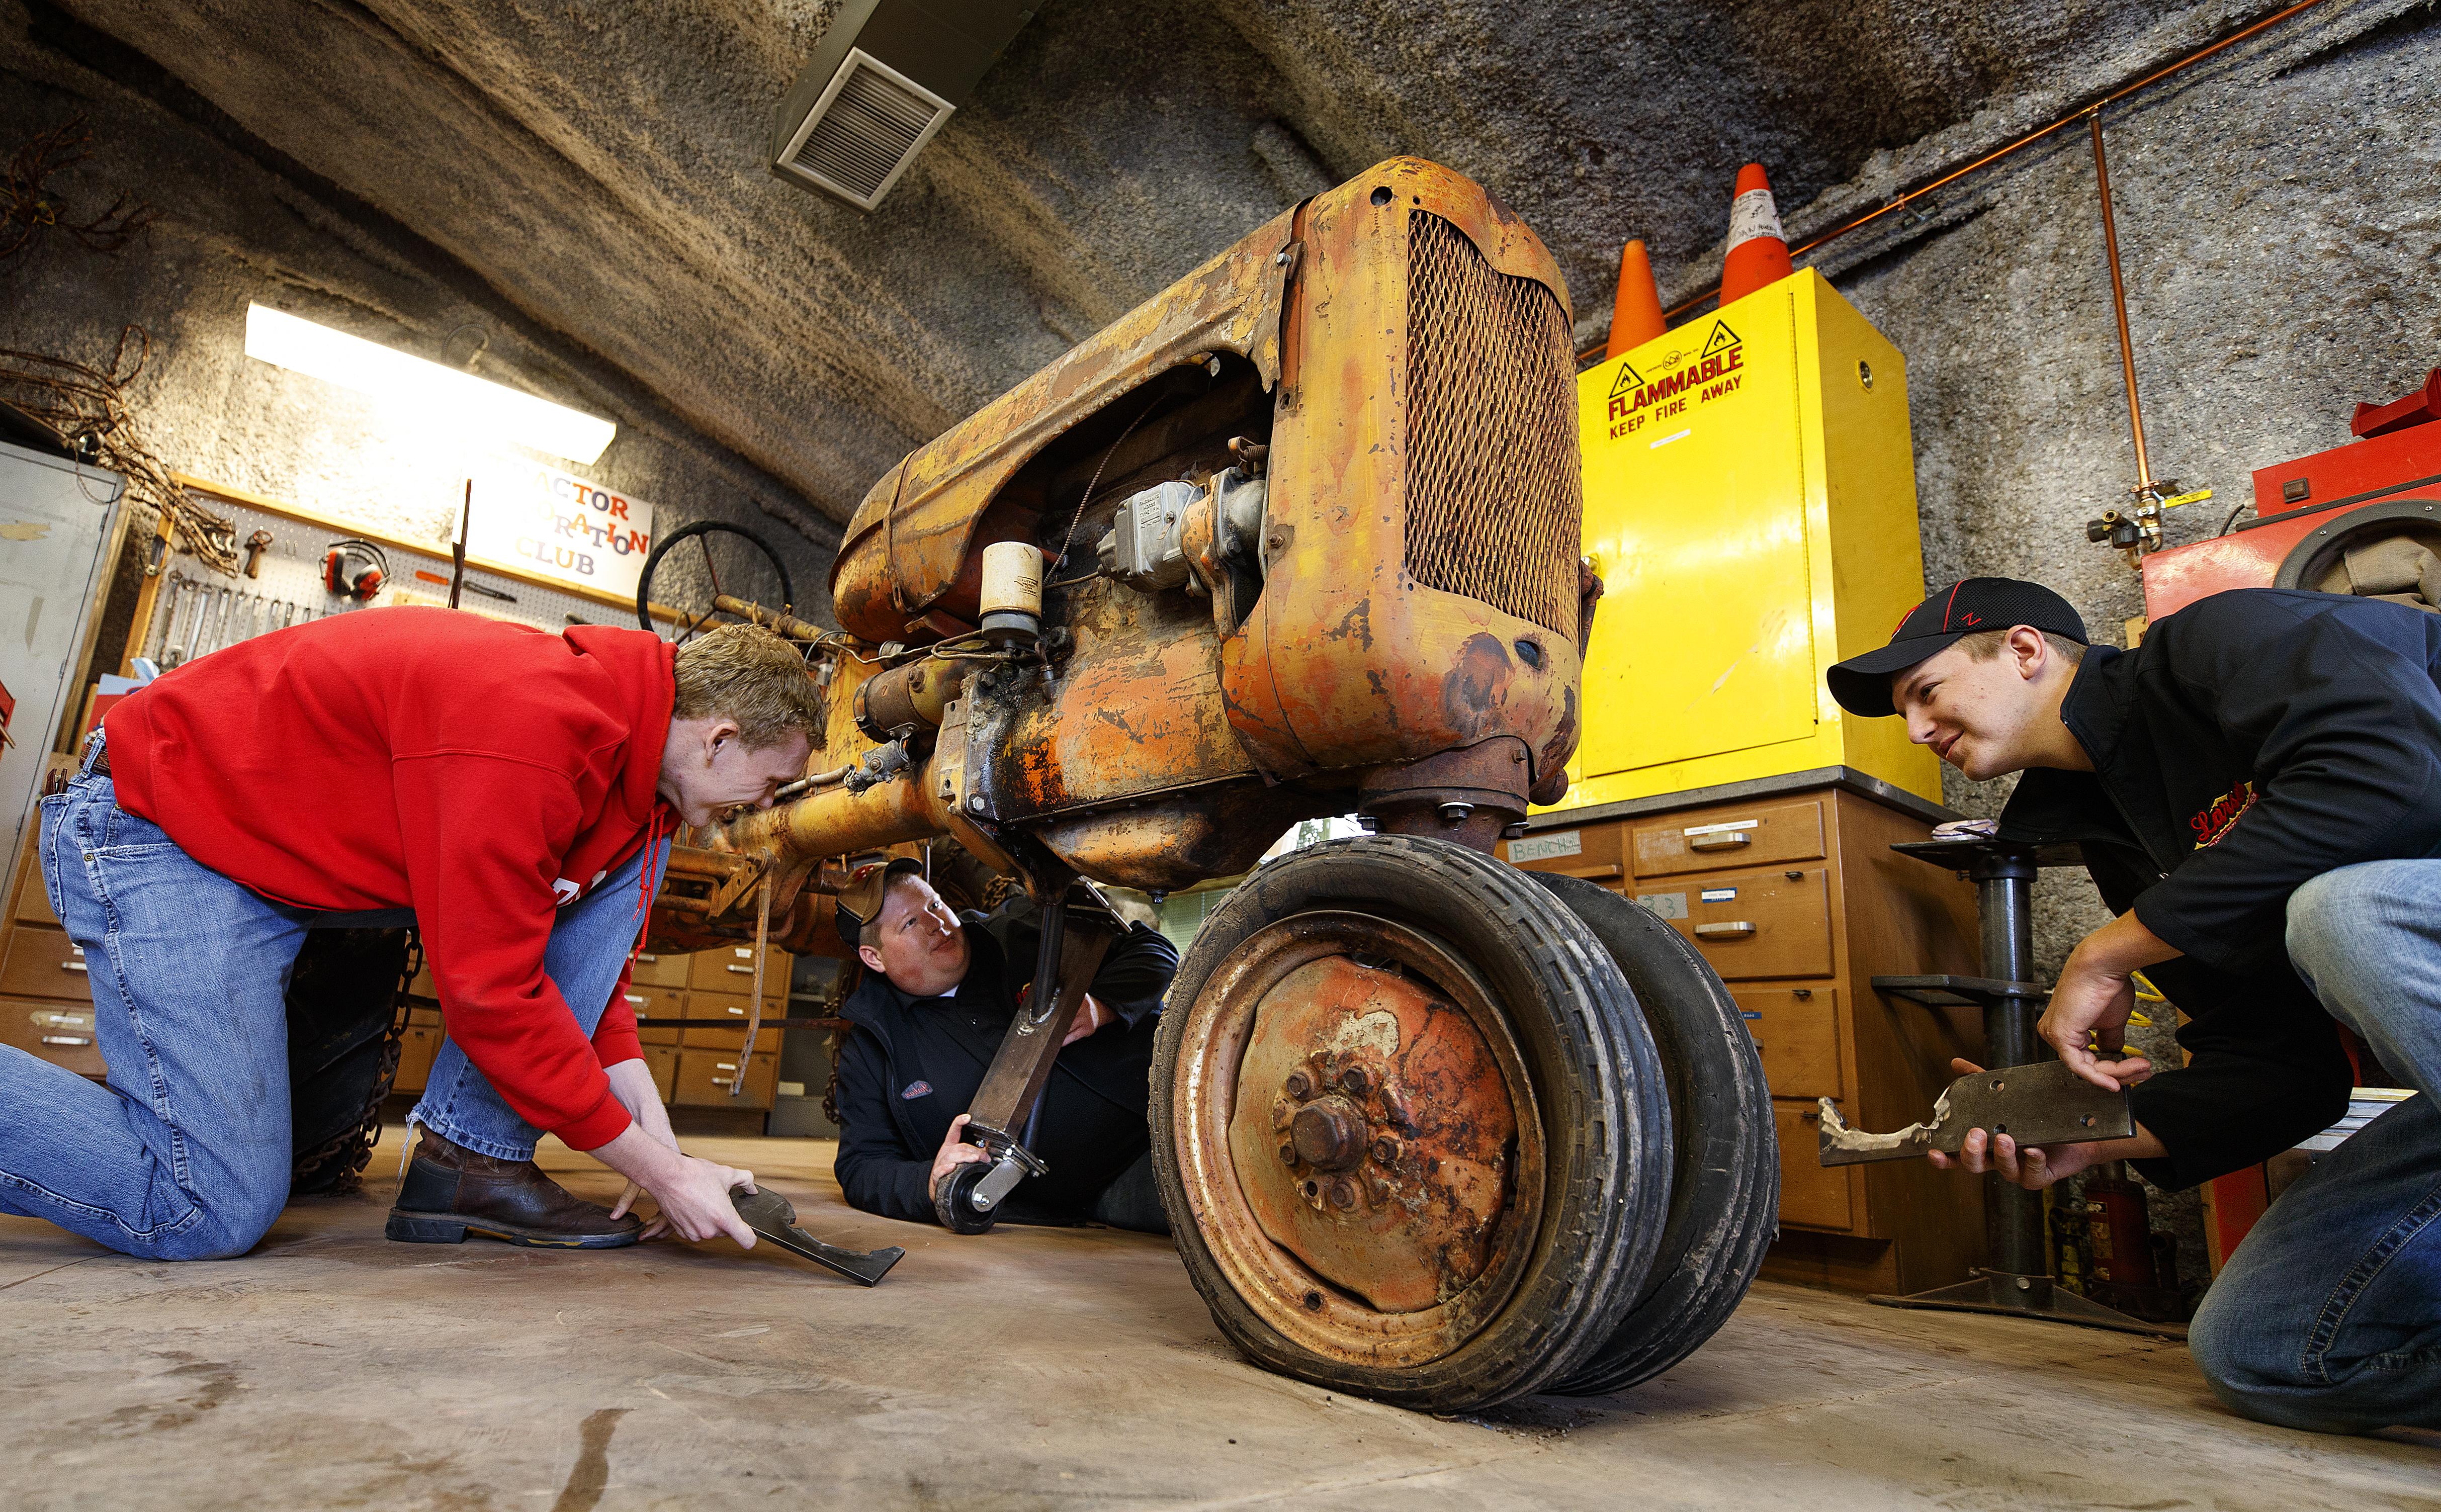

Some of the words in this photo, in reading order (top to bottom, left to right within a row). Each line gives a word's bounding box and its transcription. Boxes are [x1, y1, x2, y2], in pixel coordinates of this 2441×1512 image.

[1609, 345, 1743, 421] FLAMMABLE
[1610, 414, 1645, 440] KEEP
[1656, 398, 1687, 421] FIRE
[1701, 374, 1742, 403] AWAY
[515, 536, 595, 576] CLUB
